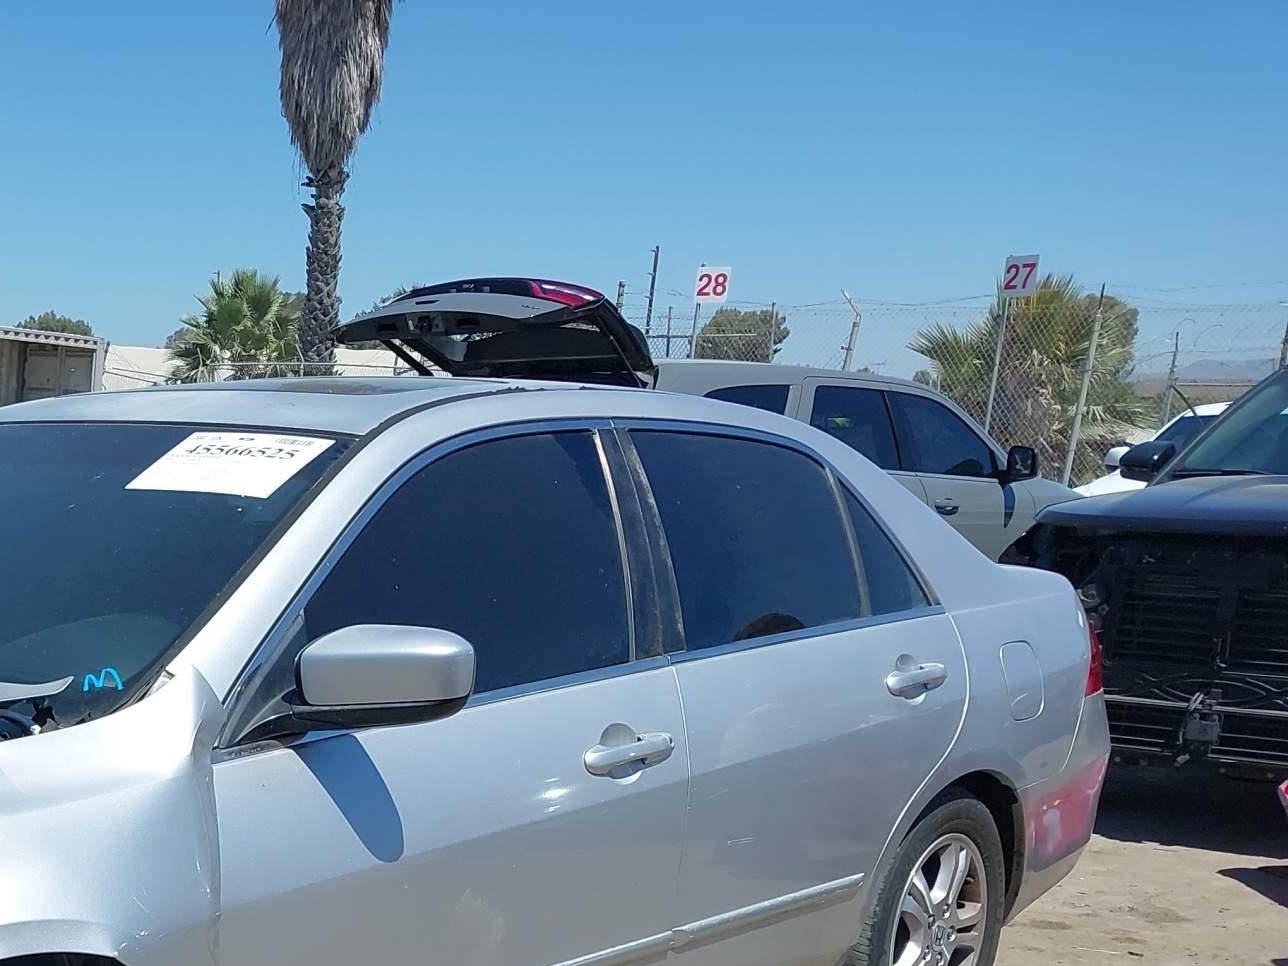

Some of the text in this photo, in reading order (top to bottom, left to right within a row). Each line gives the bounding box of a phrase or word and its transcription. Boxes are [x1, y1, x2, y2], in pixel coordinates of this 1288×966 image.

[696, 273, 728, 297] 28
[1004, 263, 1037, 290] 27
[185, 443, 300, 460] 45566525
